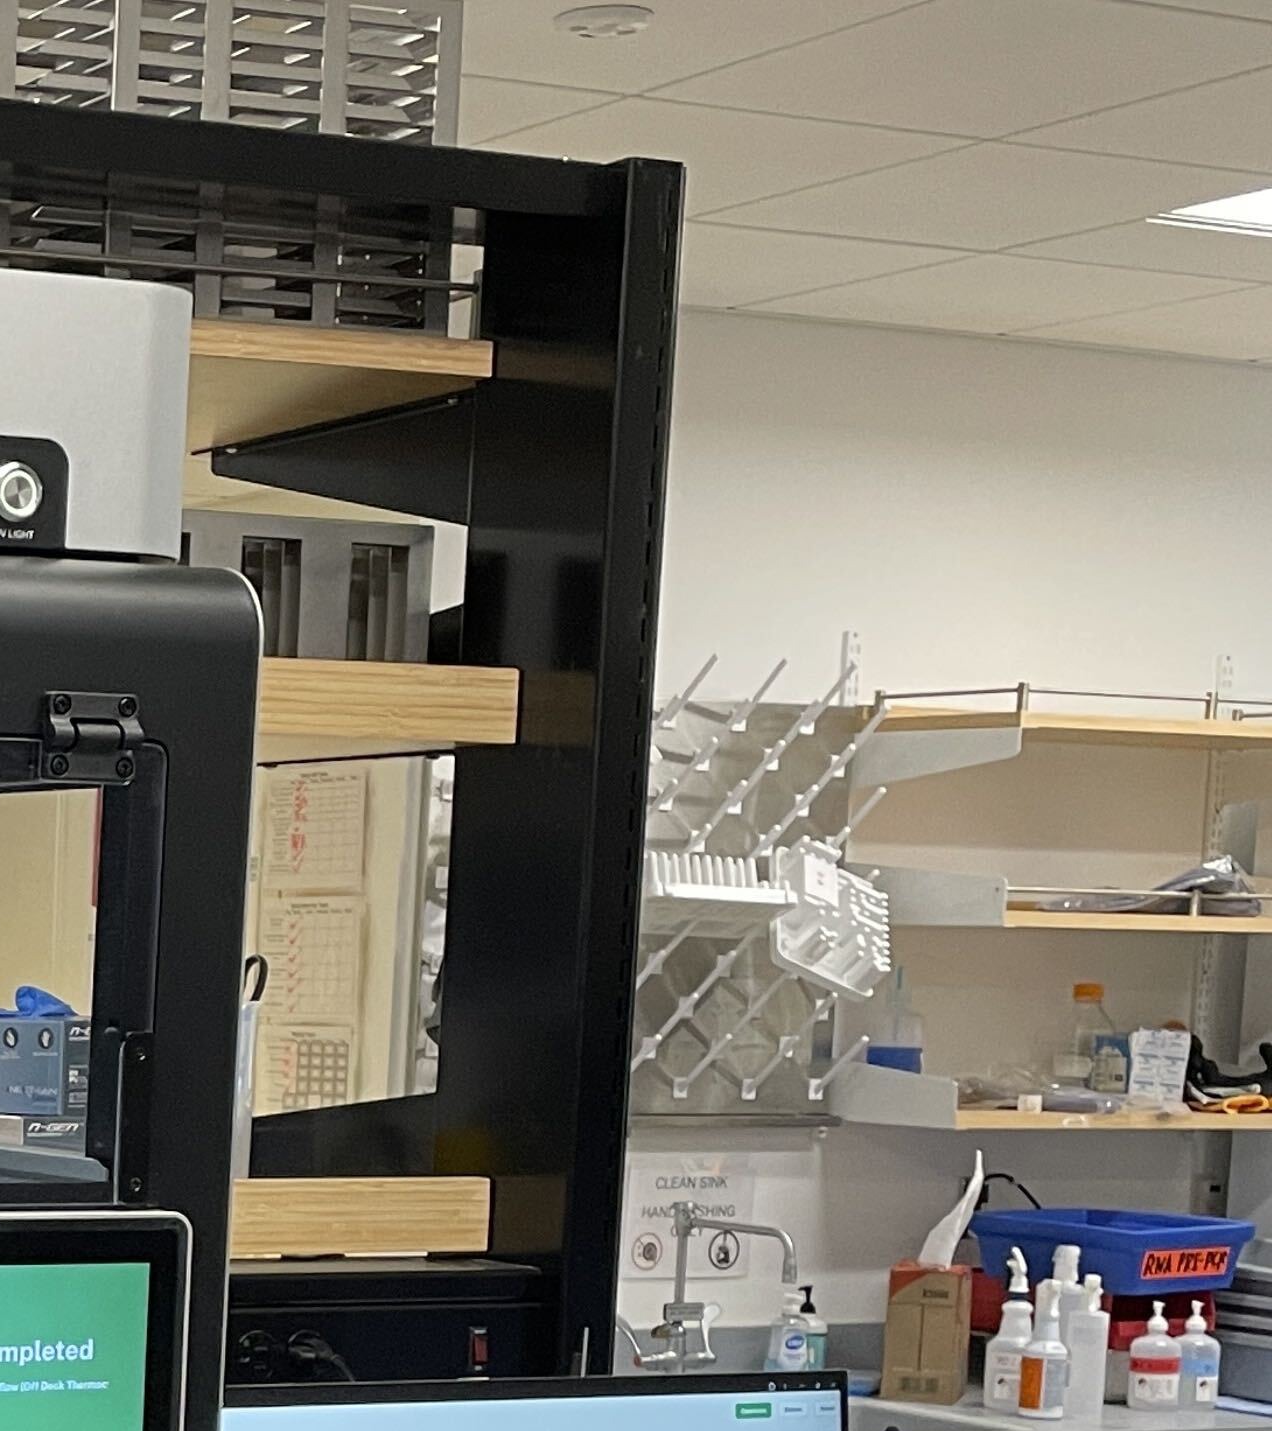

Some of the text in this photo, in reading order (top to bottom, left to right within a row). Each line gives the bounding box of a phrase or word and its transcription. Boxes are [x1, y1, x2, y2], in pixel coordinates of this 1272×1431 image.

[7, 529, 35, 540] LIGHT
[656, 1176, 728, 1189] CLEAN SINK
